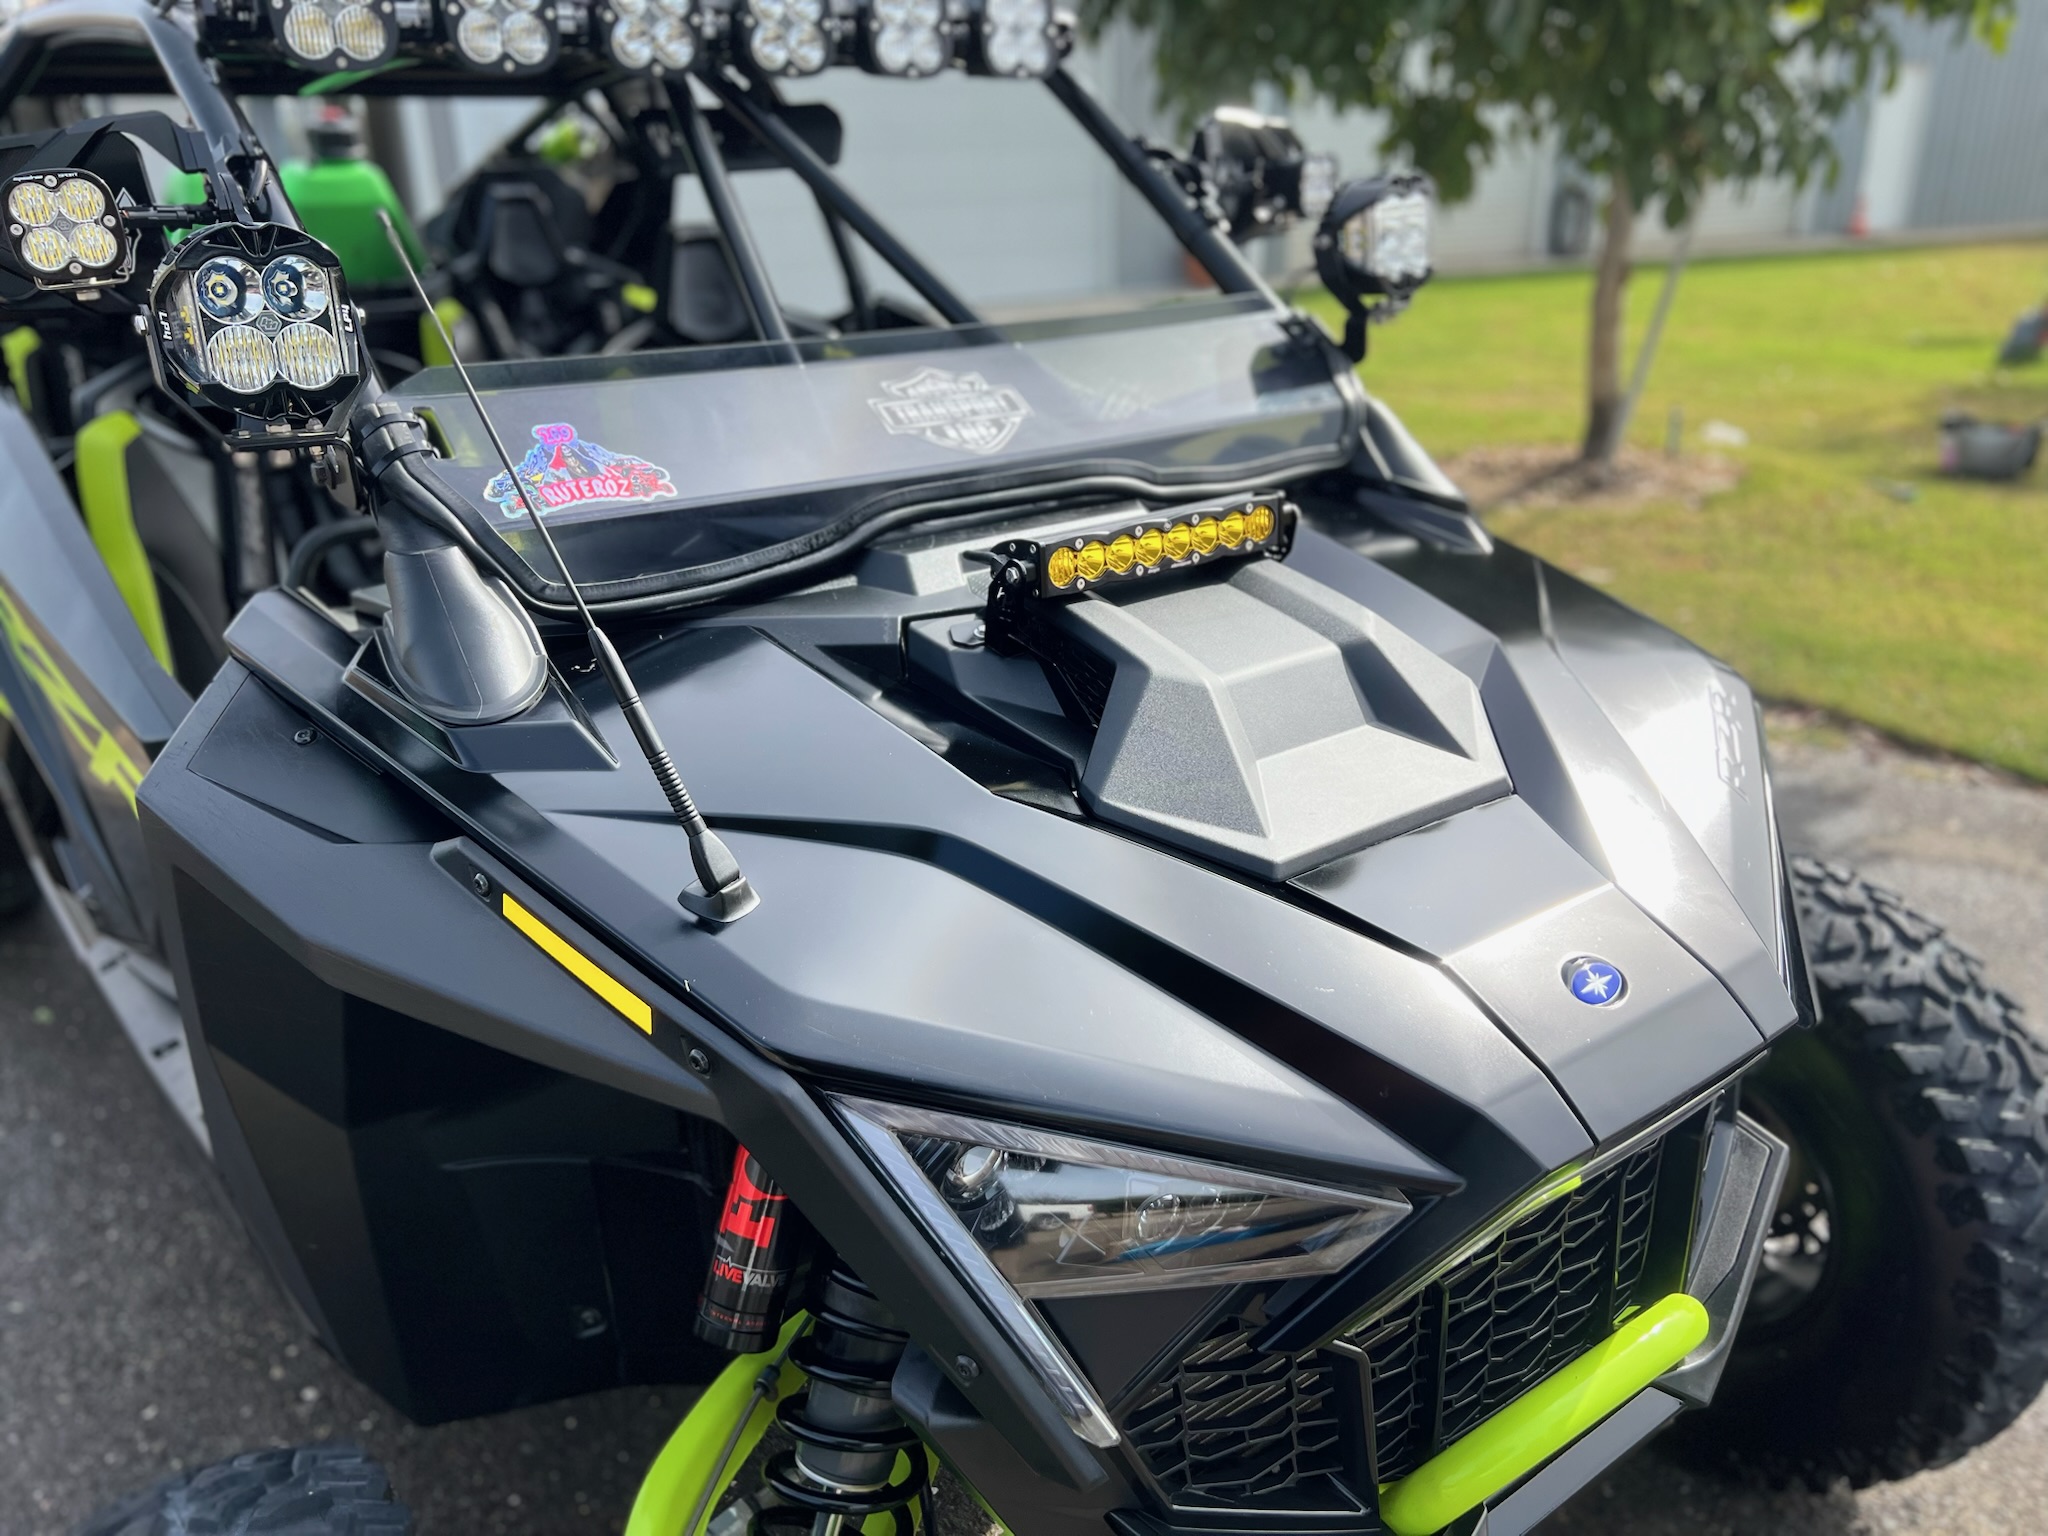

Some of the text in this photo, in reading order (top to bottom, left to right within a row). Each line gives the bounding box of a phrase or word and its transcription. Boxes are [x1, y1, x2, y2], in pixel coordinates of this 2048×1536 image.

[158, 311, 173, 340] LP4
[340, 304, 354, 333] LP4
[541, 478, 631, 505] RUTEROZ
